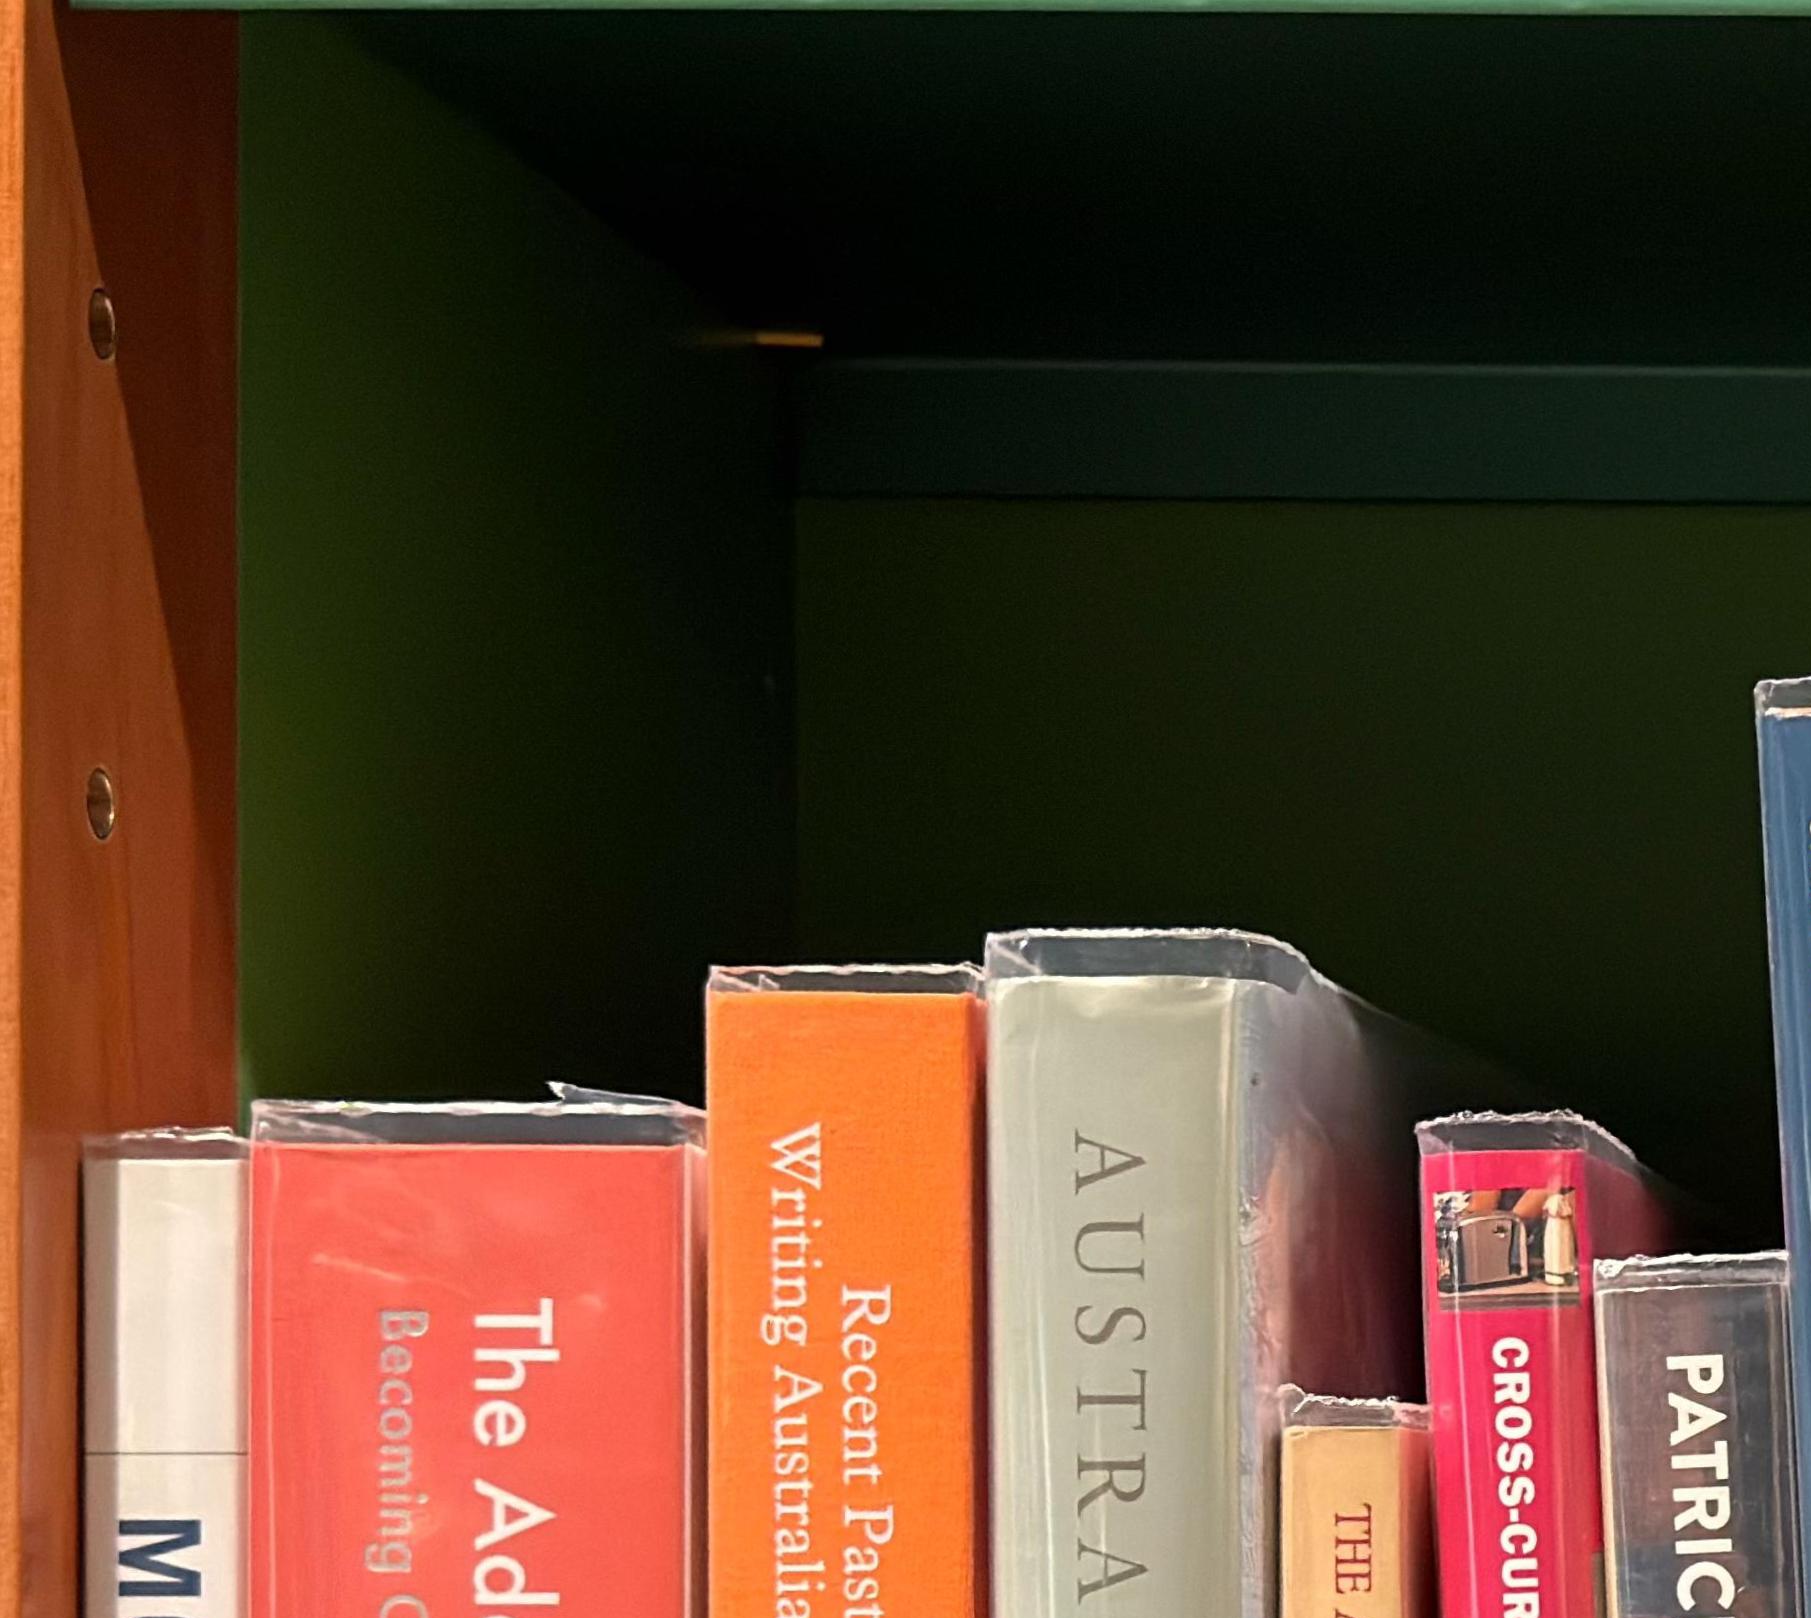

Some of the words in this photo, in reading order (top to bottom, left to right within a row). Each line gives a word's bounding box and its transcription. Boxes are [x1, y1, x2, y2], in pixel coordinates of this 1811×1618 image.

[761, 1122, 821, 1346] Writing
[364, 1310, 428, 1574] Becoming
[471, 1297, 559, 1448] The
[839, 1282, 890, 1488] Recent
[1335, 1503, 1372, 1594] THE
